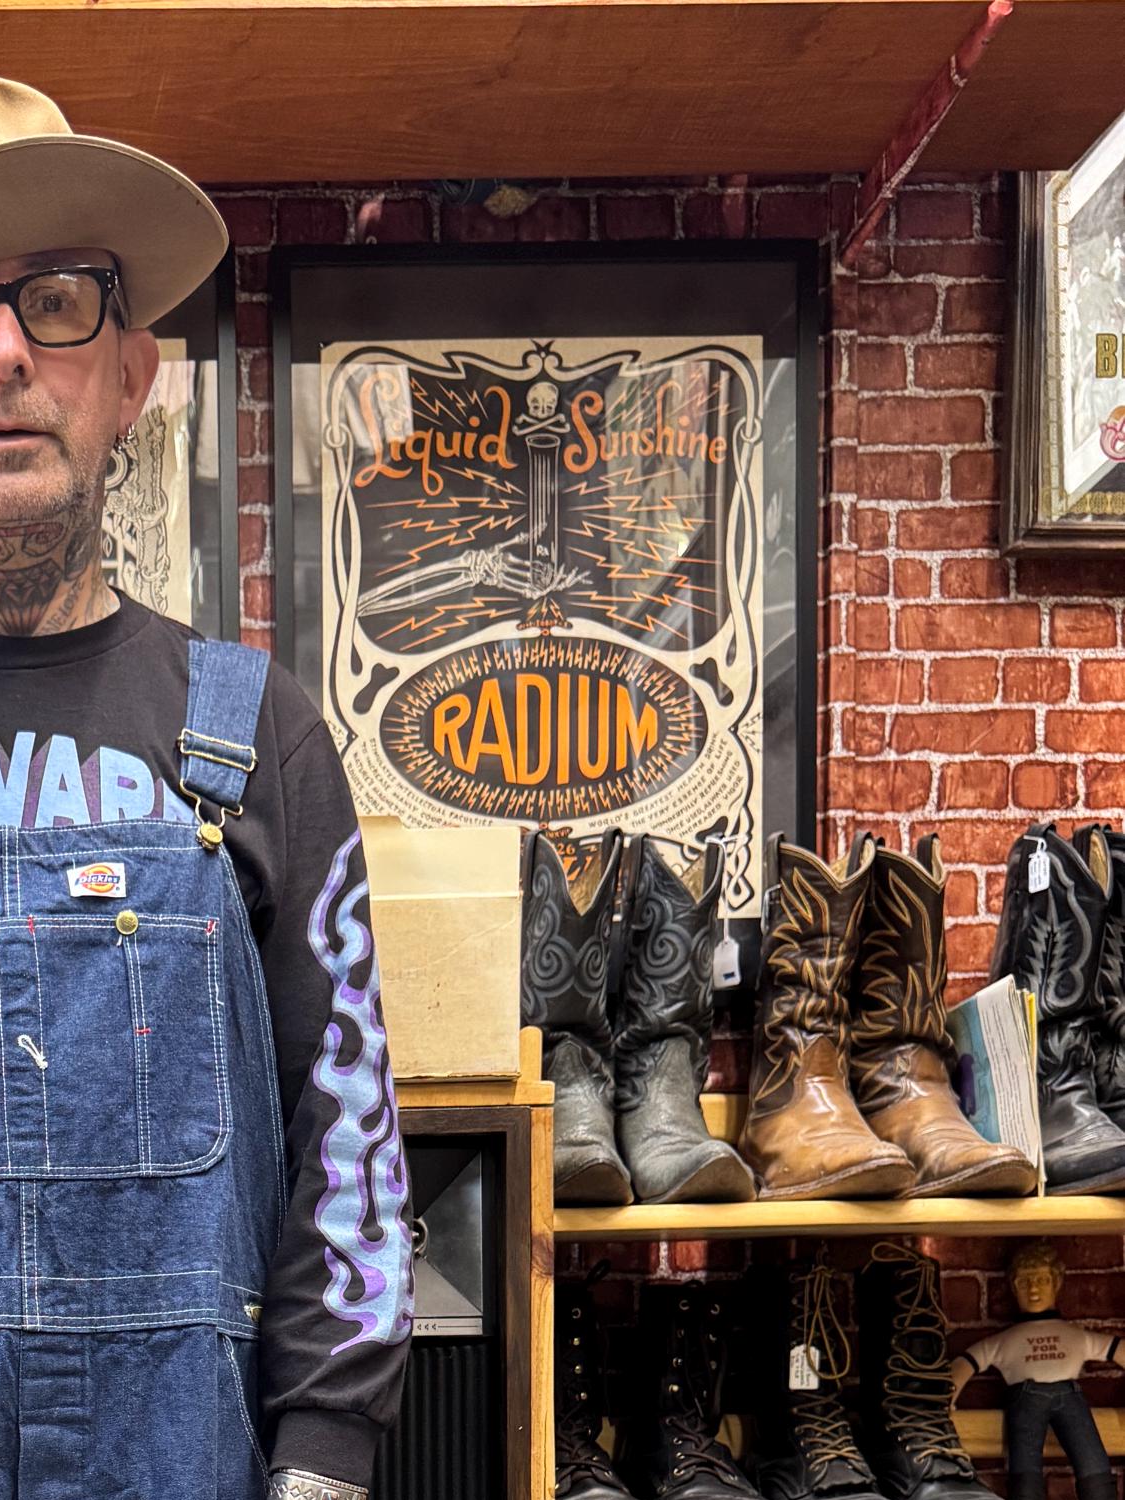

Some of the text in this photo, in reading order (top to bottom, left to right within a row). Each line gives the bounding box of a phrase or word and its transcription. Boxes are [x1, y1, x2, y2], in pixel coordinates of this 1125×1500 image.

[355, 371, 728, 496] Liquid Sunshine
[434, 673, 658, 785] RADIUM
[588, 812, 629, 828] WORLD'S
[1027, 1335, 1060, 1345] VOTE
[1033, 1344, 1057, 1352] FOR
[1025, 1352, 1066, 1362] PEDRO
